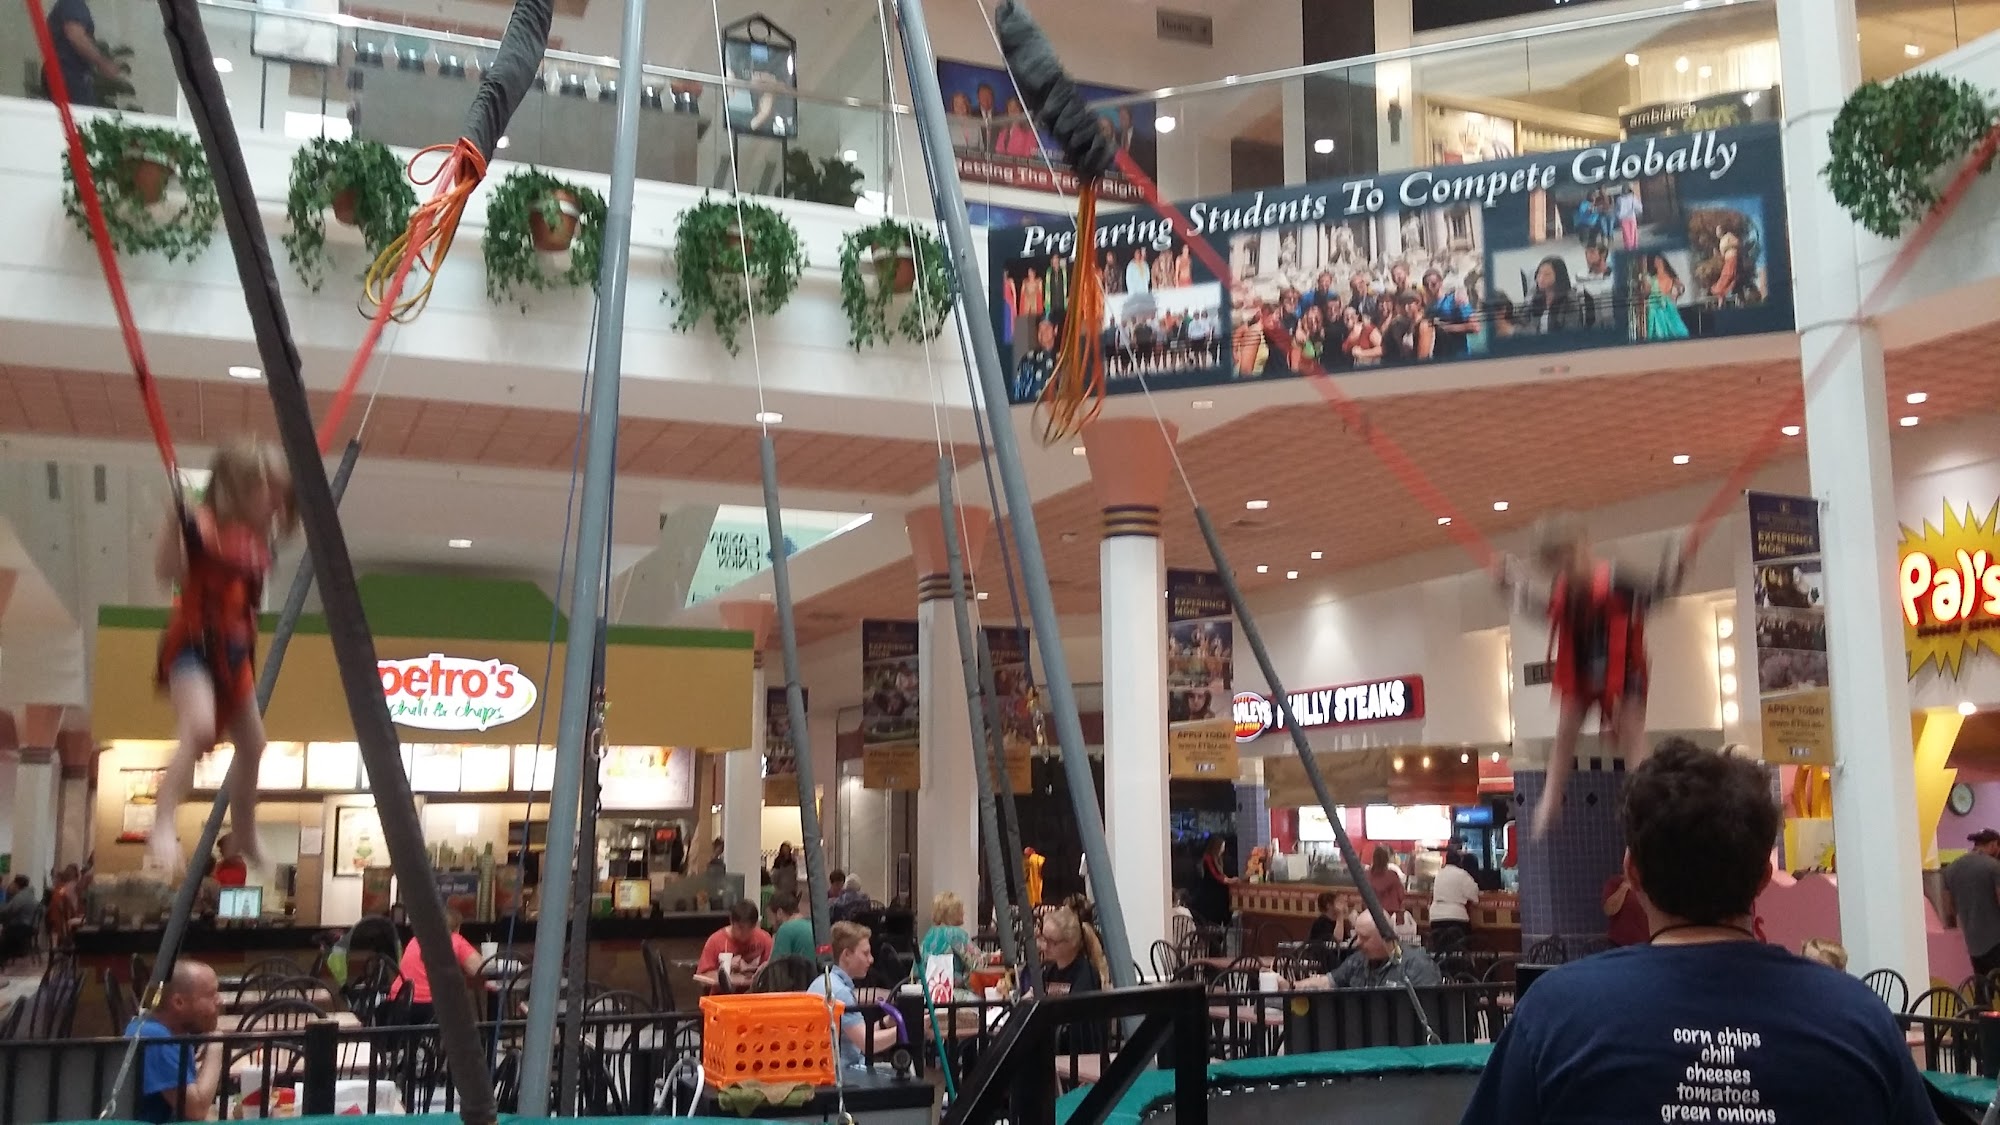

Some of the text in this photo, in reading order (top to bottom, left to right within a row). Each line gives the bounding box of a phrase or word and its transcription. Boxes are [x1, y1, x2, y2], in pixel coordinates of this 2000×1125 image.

[1187, 191, 1327, 236] Students
[1342, 178, 1384, 215] To
[1400, 162, 1556, 208] Compete
[1573, 130, 1737, 184] Globally
[1899, 547, 2000, 627] Pal's
[378, 660, 515, 699] petro's
[1334, 679, 1405, 723] STEAKS
[1673, 1026, 1761, 1051] corn chips
[1686, 1061, 1751, 1085] cheeses
[1676, 1082, 1760, 1103] tomatoes
[1661, 1104, 1777, 1124] green onions
